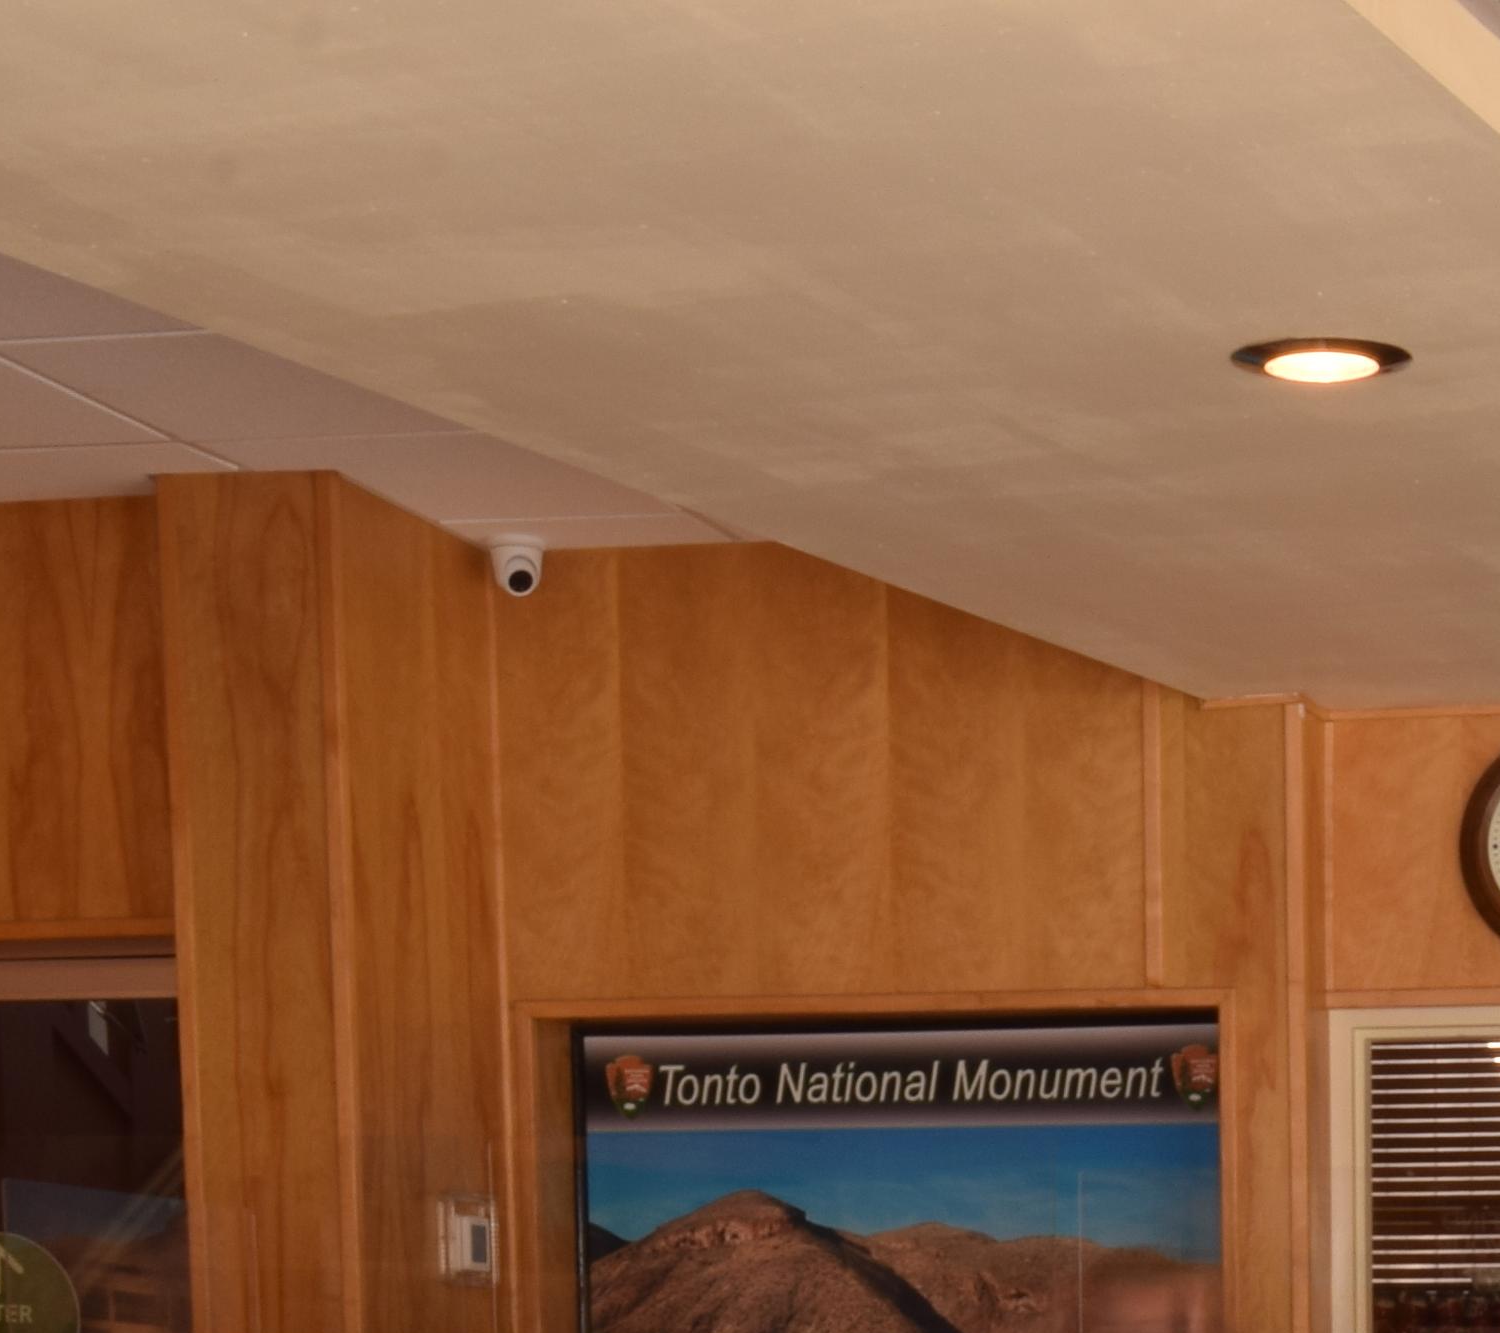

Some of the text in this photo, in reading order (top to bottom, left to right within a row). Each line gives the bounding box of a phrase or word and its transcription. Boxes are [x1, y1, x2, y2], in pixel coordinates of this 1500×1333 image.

[657, 1056, 1166, 1107] Tonto National Monument
